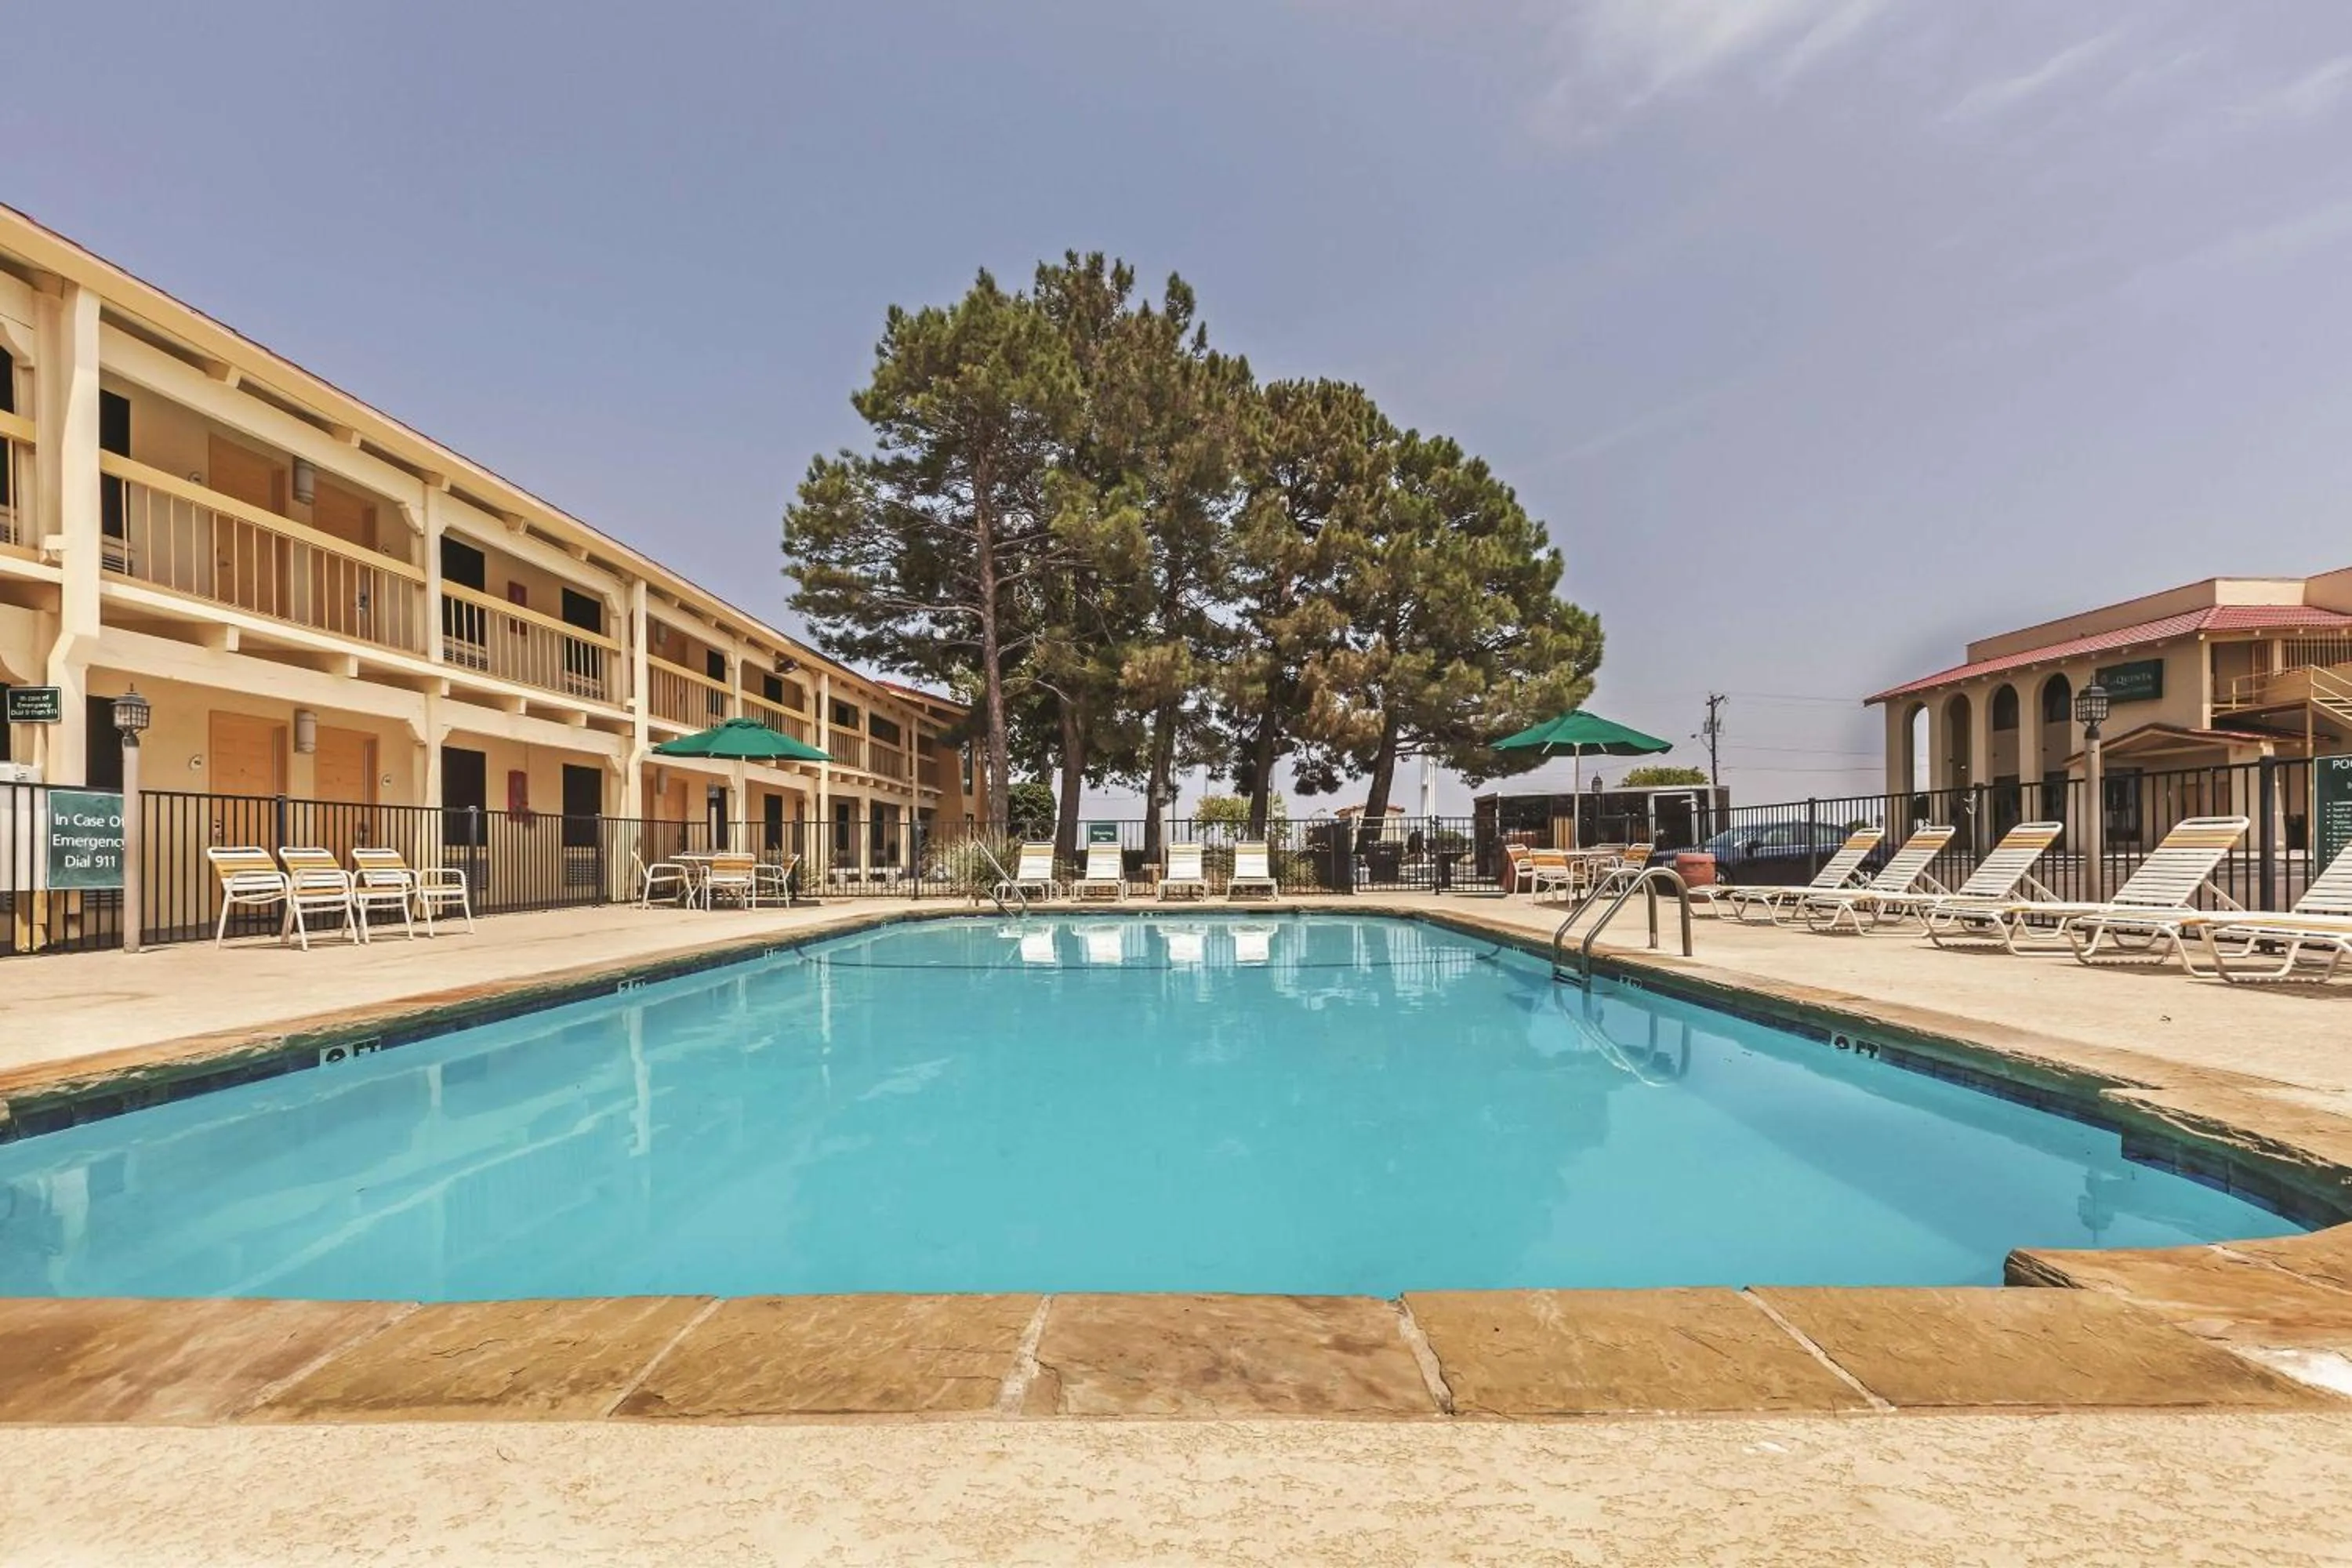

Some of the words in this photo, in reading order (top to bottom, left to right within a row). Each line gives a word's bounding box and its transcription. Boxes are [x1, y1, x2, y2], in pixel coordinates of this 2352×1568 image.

[55, 813, 68, 826] In
[73, 813, 105, 827] Case
[65, 854, 90, 868] Dial
[95, 855, 115, 868] 911
